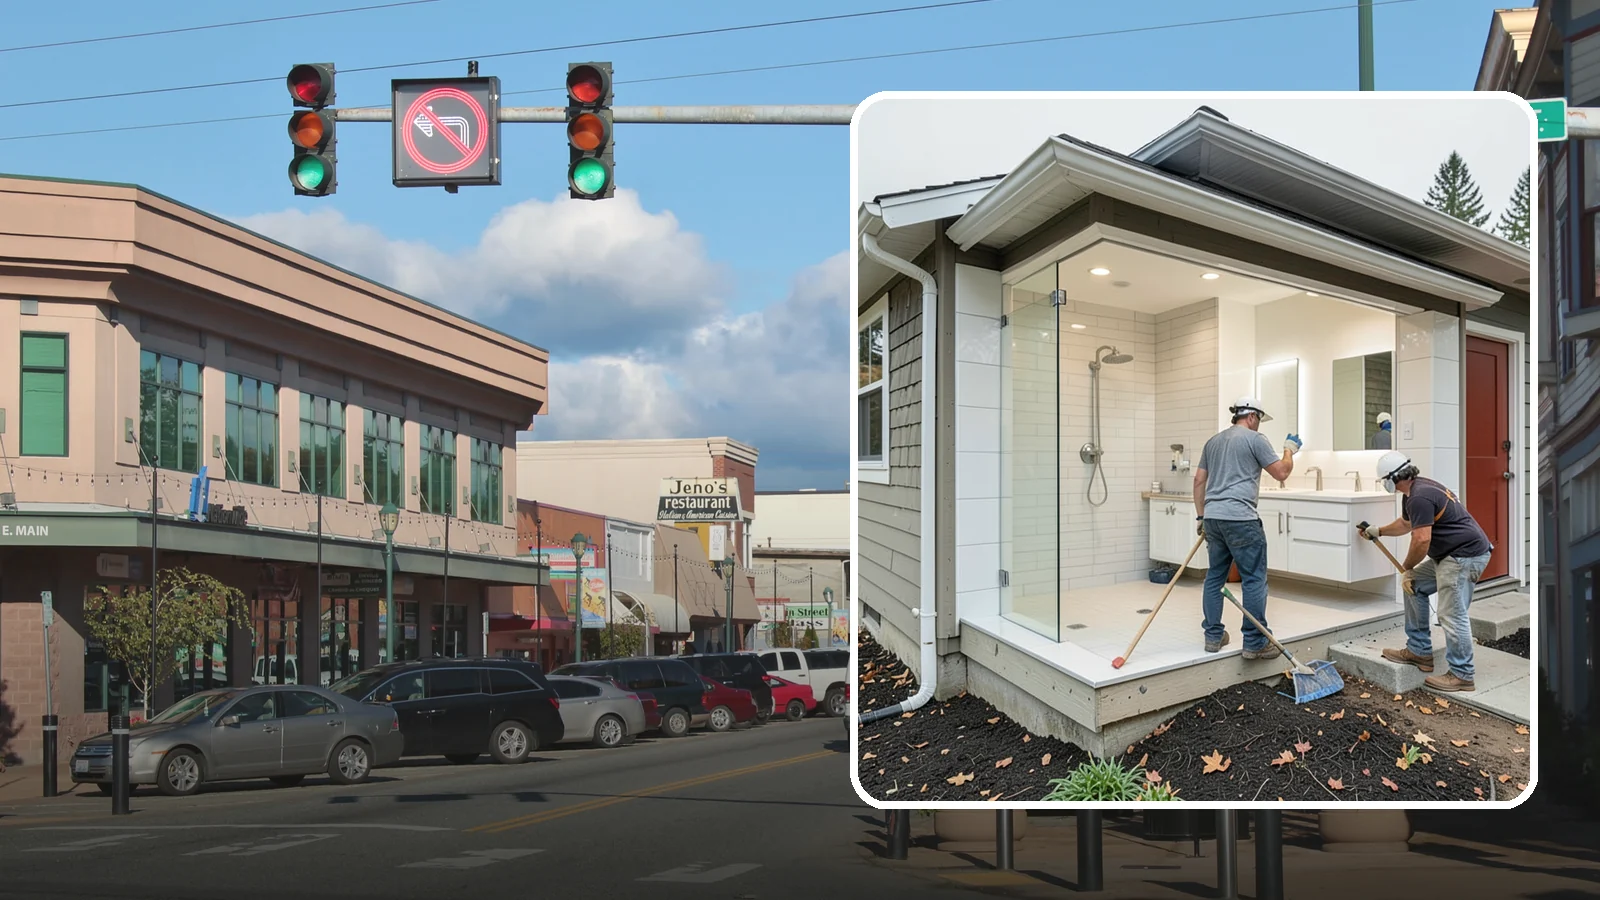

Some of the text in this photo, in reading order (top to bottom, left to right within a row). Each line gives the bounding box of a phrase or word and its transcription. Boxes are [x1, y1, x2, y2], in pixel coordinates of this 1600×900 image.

[669, 480, 727, 494] Jeno's
[665, 497, 731, 509] restaurant
[658, 509, 681, 519] Italian
[686, 509, 714, 519] American
[714, 509, 737, 519] Cuisine
[2, 525, 49, 536] E. MAIN
[797, 607, 828, 617] Street
[788, 619, 824, 627] lass
